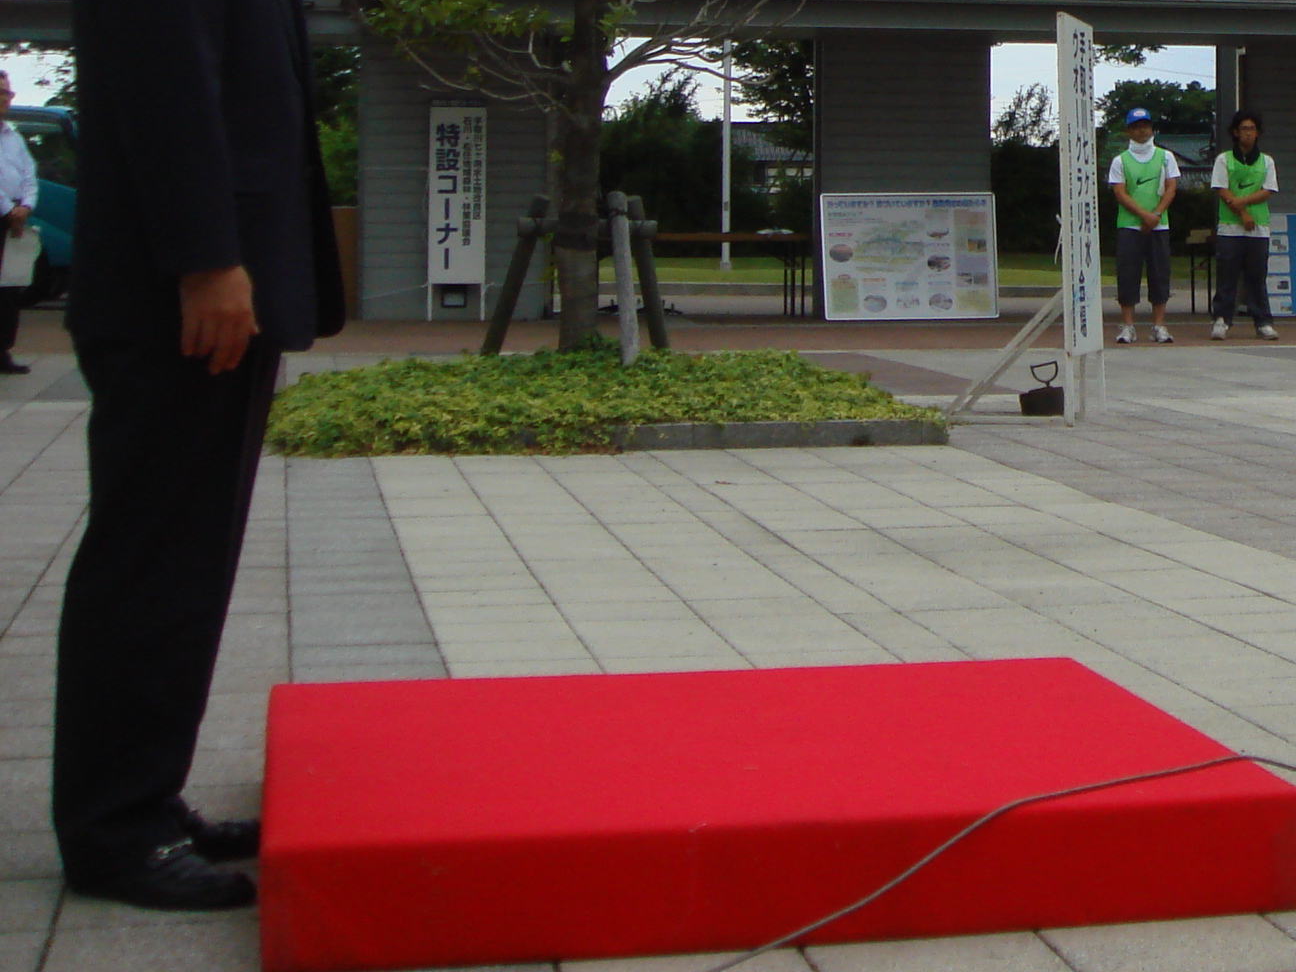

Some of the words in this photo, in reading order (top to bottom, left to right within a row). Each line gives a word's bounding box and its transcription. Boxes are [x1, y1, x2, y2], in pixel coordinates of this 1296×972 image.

[436, 123, 461, 270] 特設コーナー
